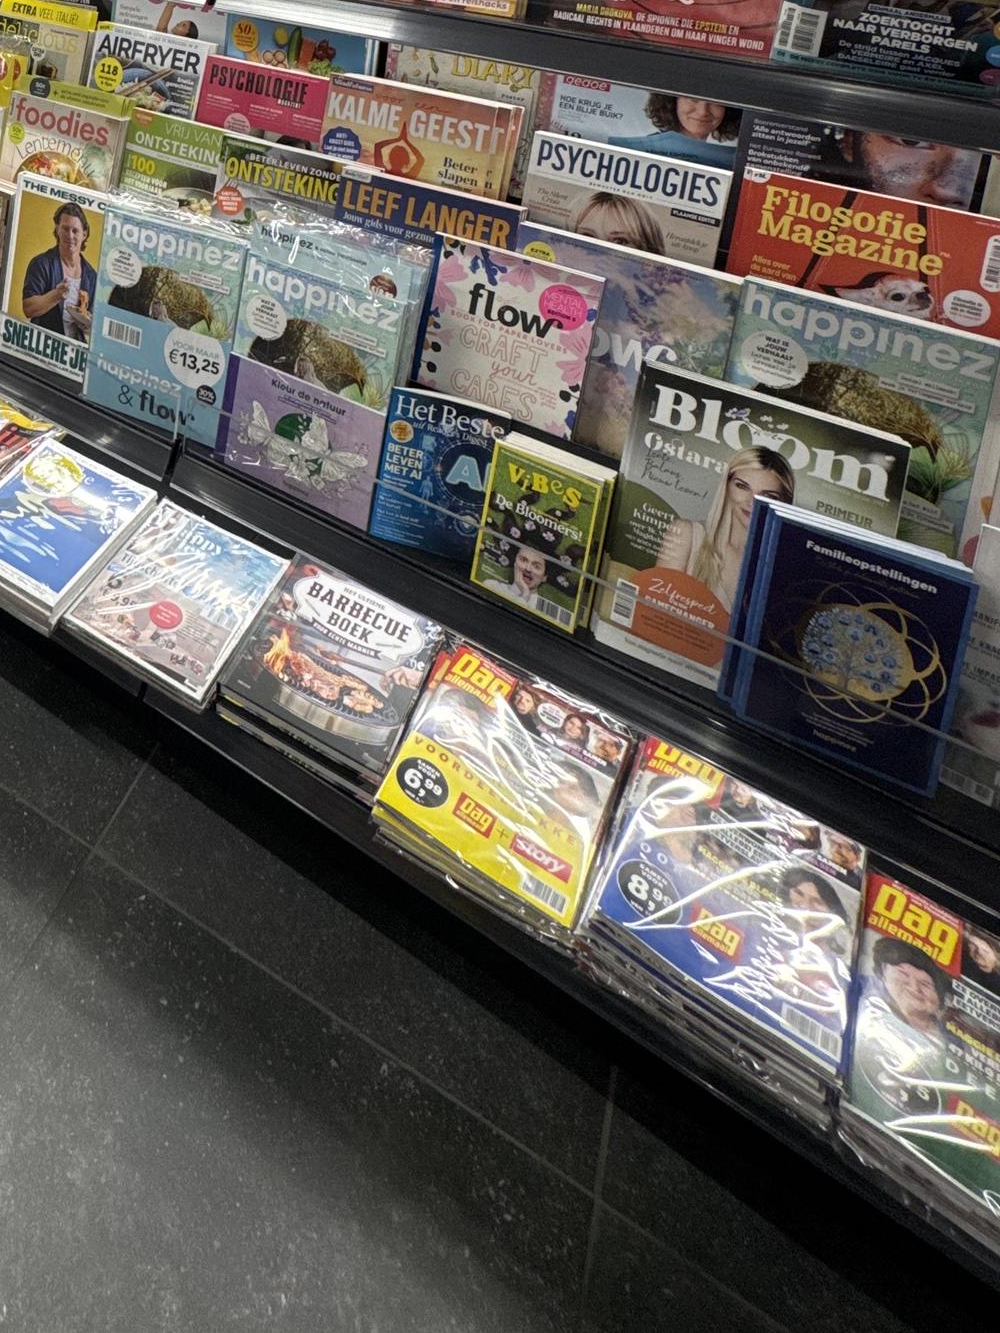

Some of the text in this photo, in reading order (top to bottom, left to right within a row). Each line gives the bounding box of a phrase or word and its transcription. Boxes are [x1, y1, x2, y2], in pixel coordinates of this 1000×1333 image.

[11, 2, 54, 19] EXTRA VEEL
[553, 10, 764, 51] RADICAAL RECHTS VLAANDEREN OM HAAR VINGER WOND
[647, 14, 740, 35] SPIONNE DIE EPSTEIN EN
[859, 12, 955, 35] ZOEKTOCHT
[98, 33, 201, 76] AIRFRYER
[833, 18, 977, 53] NAAR VERBORGEN
[871, 34, 931, 54] PARELS
[100, 62, 119, 76] 118
[209, 63, 309, 105] PSYCHOLOGIE
[451, 55, 540, 93] DIARY
[16, 97, 109, 147] foodies
[327, 91, 400, 133] KALME
[559, 102, 623, 121] EEN BLIJE BUIK?
[560, 94, 602, 109] HOE KRIJG
[164, 122, 222, 147] VRIJ VAN
[225, 155, 341, 205] ONTSTEKING
[278, 158, 306, 174] LEVEN
[438, 169, 478, 189] slapen
[443, 156, 479, 174] Beter
[537, 139, 721, 207] PSYCHOLOGIES
[49, 186, 95, 210] MESSY
[343, 176, 511, 250] LEEF LANGER
[762, 185, 927, 245] Filosofie
[107, 215, 242, 273] happinez
[757, 210, 944, 276] Magazine
[248, 255, 399, 333] happinez
[469, 282, 563, 339] flow
[3, 319, 69, 365] SNELLERE
[460, 324, 548, 371] CRAFT
[744, 284, 995, 382] happinez
[169, 348, 221, 378] €13,25
[139, 389, 197, 430] flow
[271, 377, 347, 417] Kleur natuur
[450, 368, 538, 421] CARES
[395, 394, 505, 442] Het Beste
[386, 453, 423, 470] LEVEN
[388, 444, 424, 459] BETER
[644, 430, 729, 474] Ostara
[648, 383, 891, 502] Bloom
[495, 493, 584, 543] De Bloomers!
[806, 539, 938, 596] Familieopstellingen
[307, 580, 414, 645] BARBECUE
[327, 612, 375, 645] BOEK
[453, 651, 513, 703] Dag
[460, 795, 493, 825] Dag
[697, 910, 741, 955] Dag
[873, 883, 960, 967] Dag
